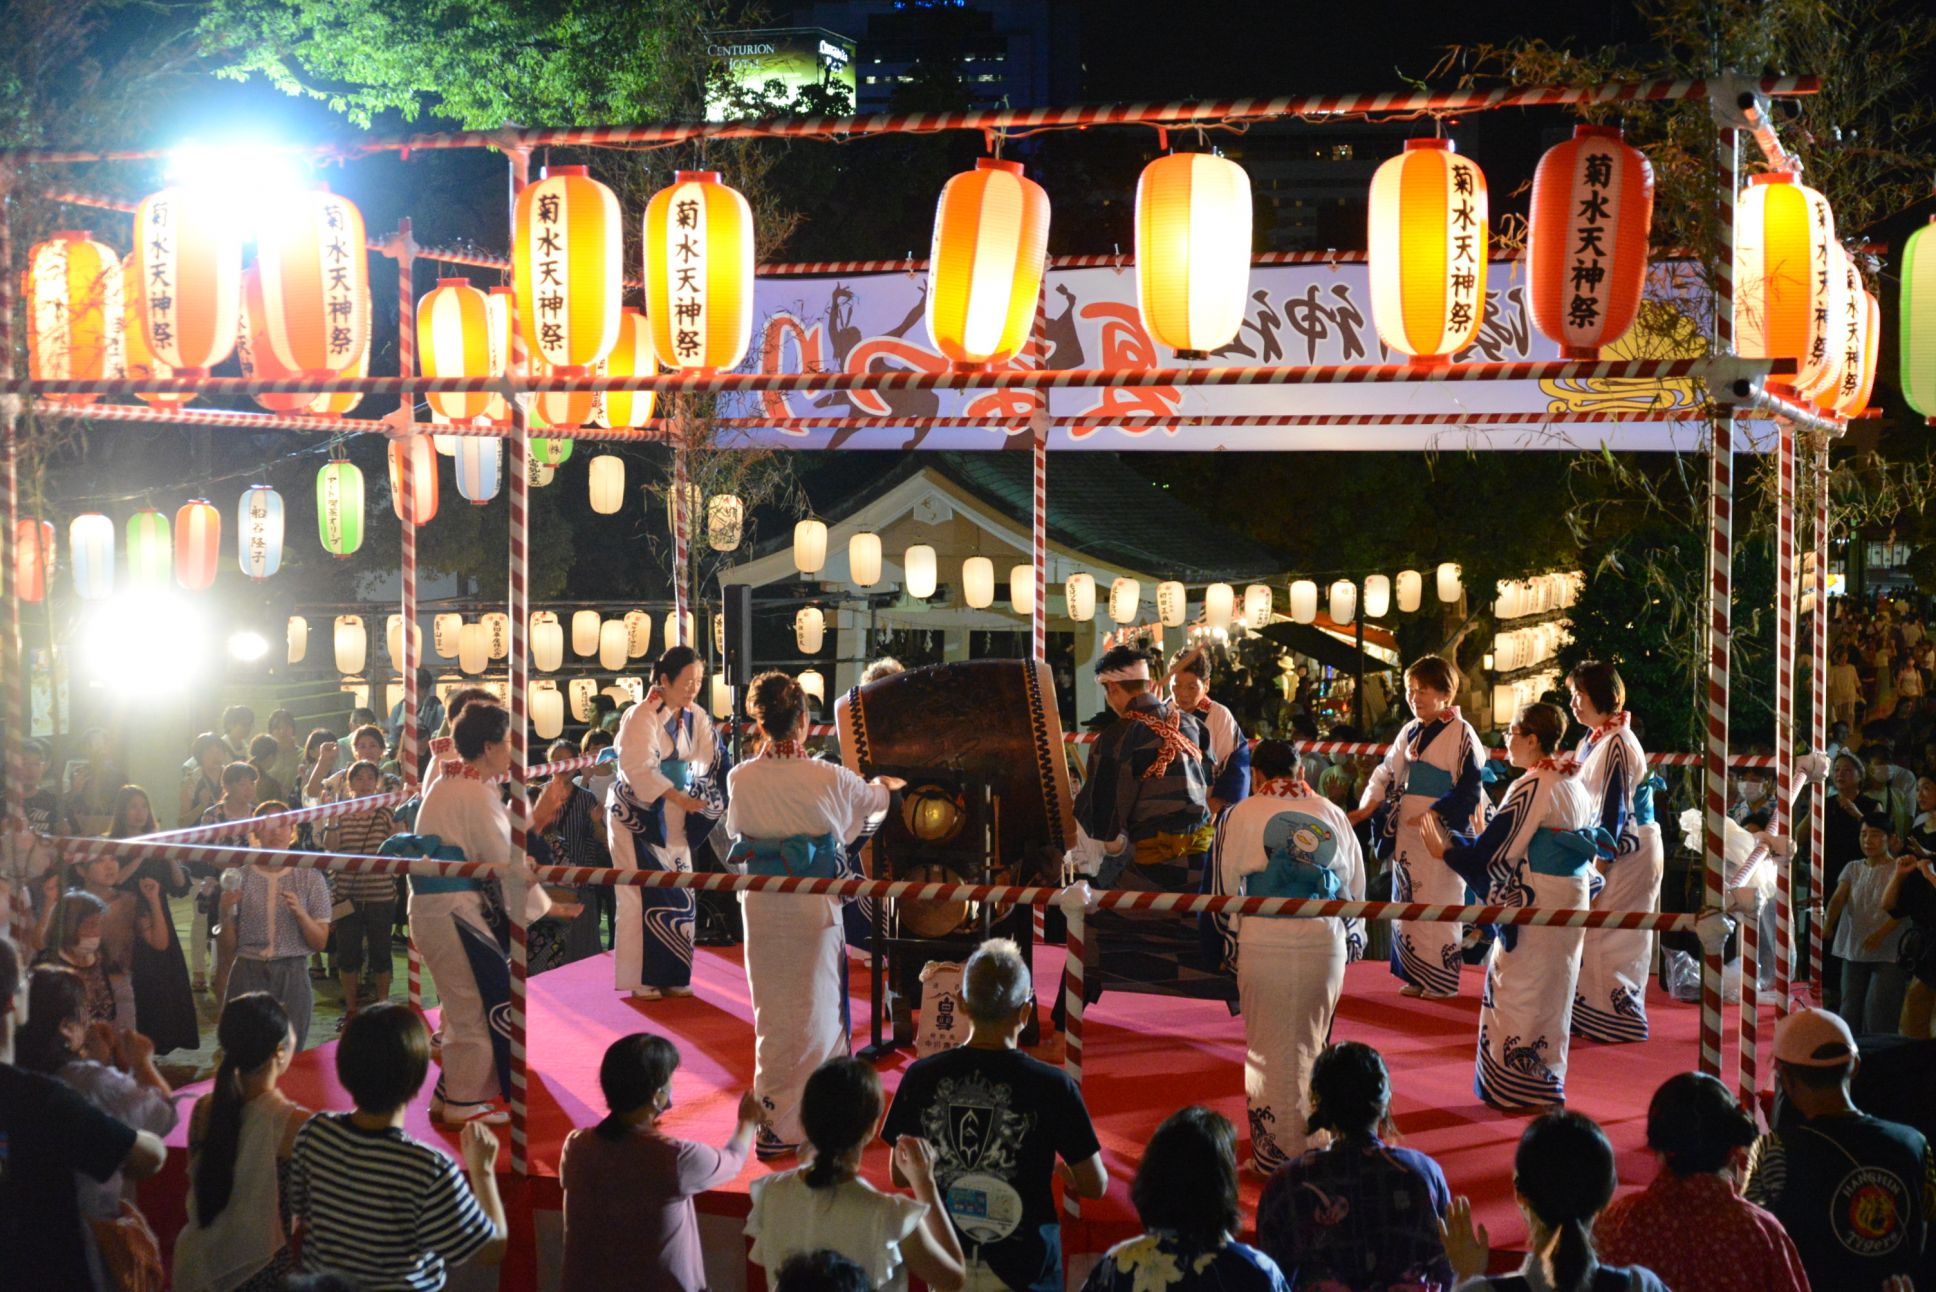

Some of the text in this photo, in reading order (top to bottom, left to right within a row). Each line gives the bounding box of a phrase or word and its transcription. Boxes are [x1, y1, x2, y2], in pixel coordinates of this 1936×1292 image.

[707, 43, 775, 57] CENTURION
[150, 202, 173, 350] 菊水天神祭
[325, 204, 353, 355] 菊水天神祭
[537, 193, 565, 352] 菊水天神祭
[674, 200, 702, 358] 菊水天神祭
[1448, 164, 1477, 334] 菊水天神祭
[1568, 153, 1613, 329] 菊水天神祭
